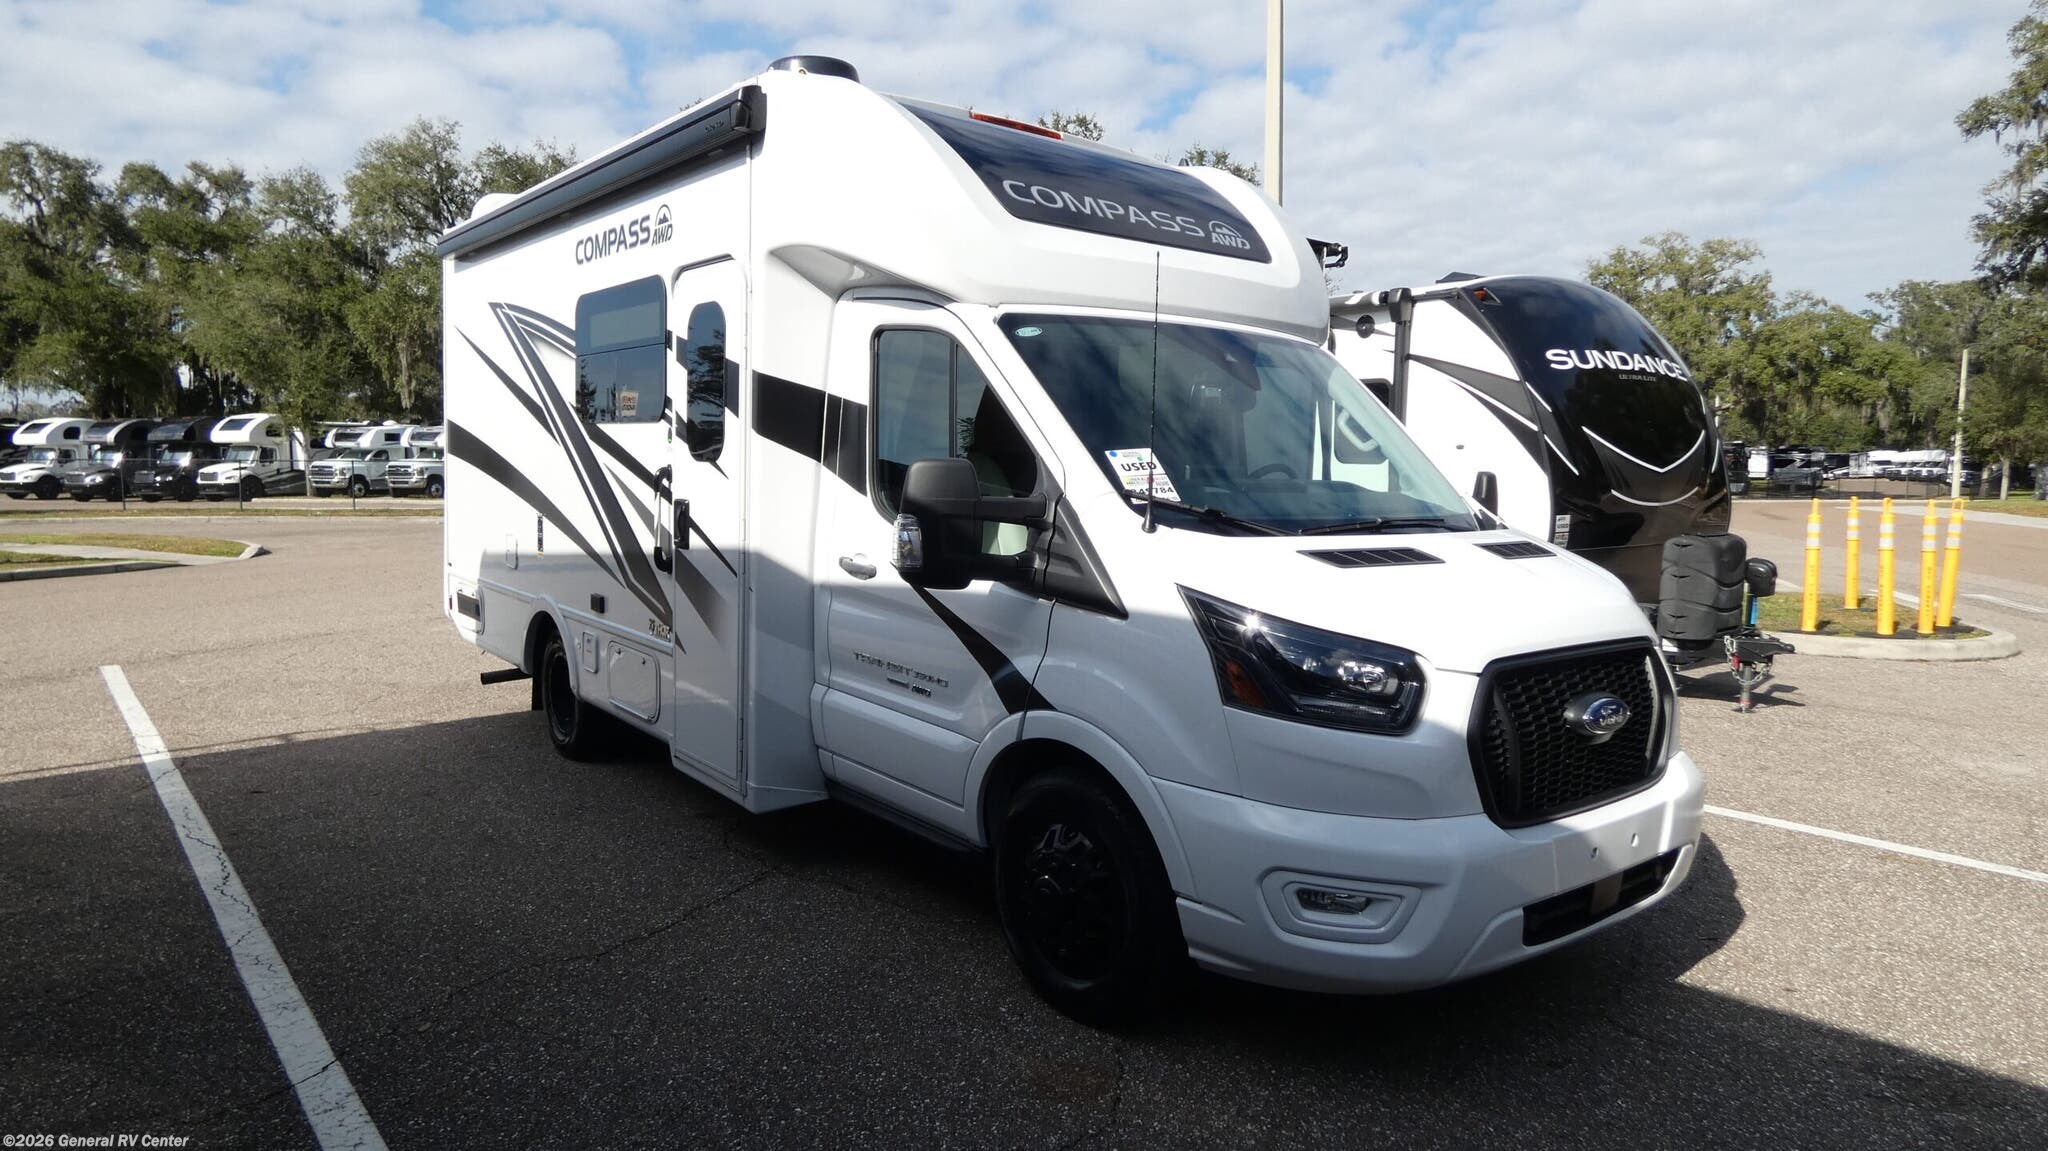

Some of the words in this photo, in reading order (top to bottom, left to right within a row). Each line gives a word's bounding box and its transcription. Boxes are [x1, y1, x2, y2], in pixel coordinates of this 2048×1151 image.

[1002, 179, 1205, 238] COMPASS
[1211, 231, 1251, 250] AWD
[575, 214, 651, 265] COMPASS
[651, 223, 673, 247] AWD
[1545, 349, 1688, 381] SUNDANCE
[1120, 462, 1157, 472] USED
